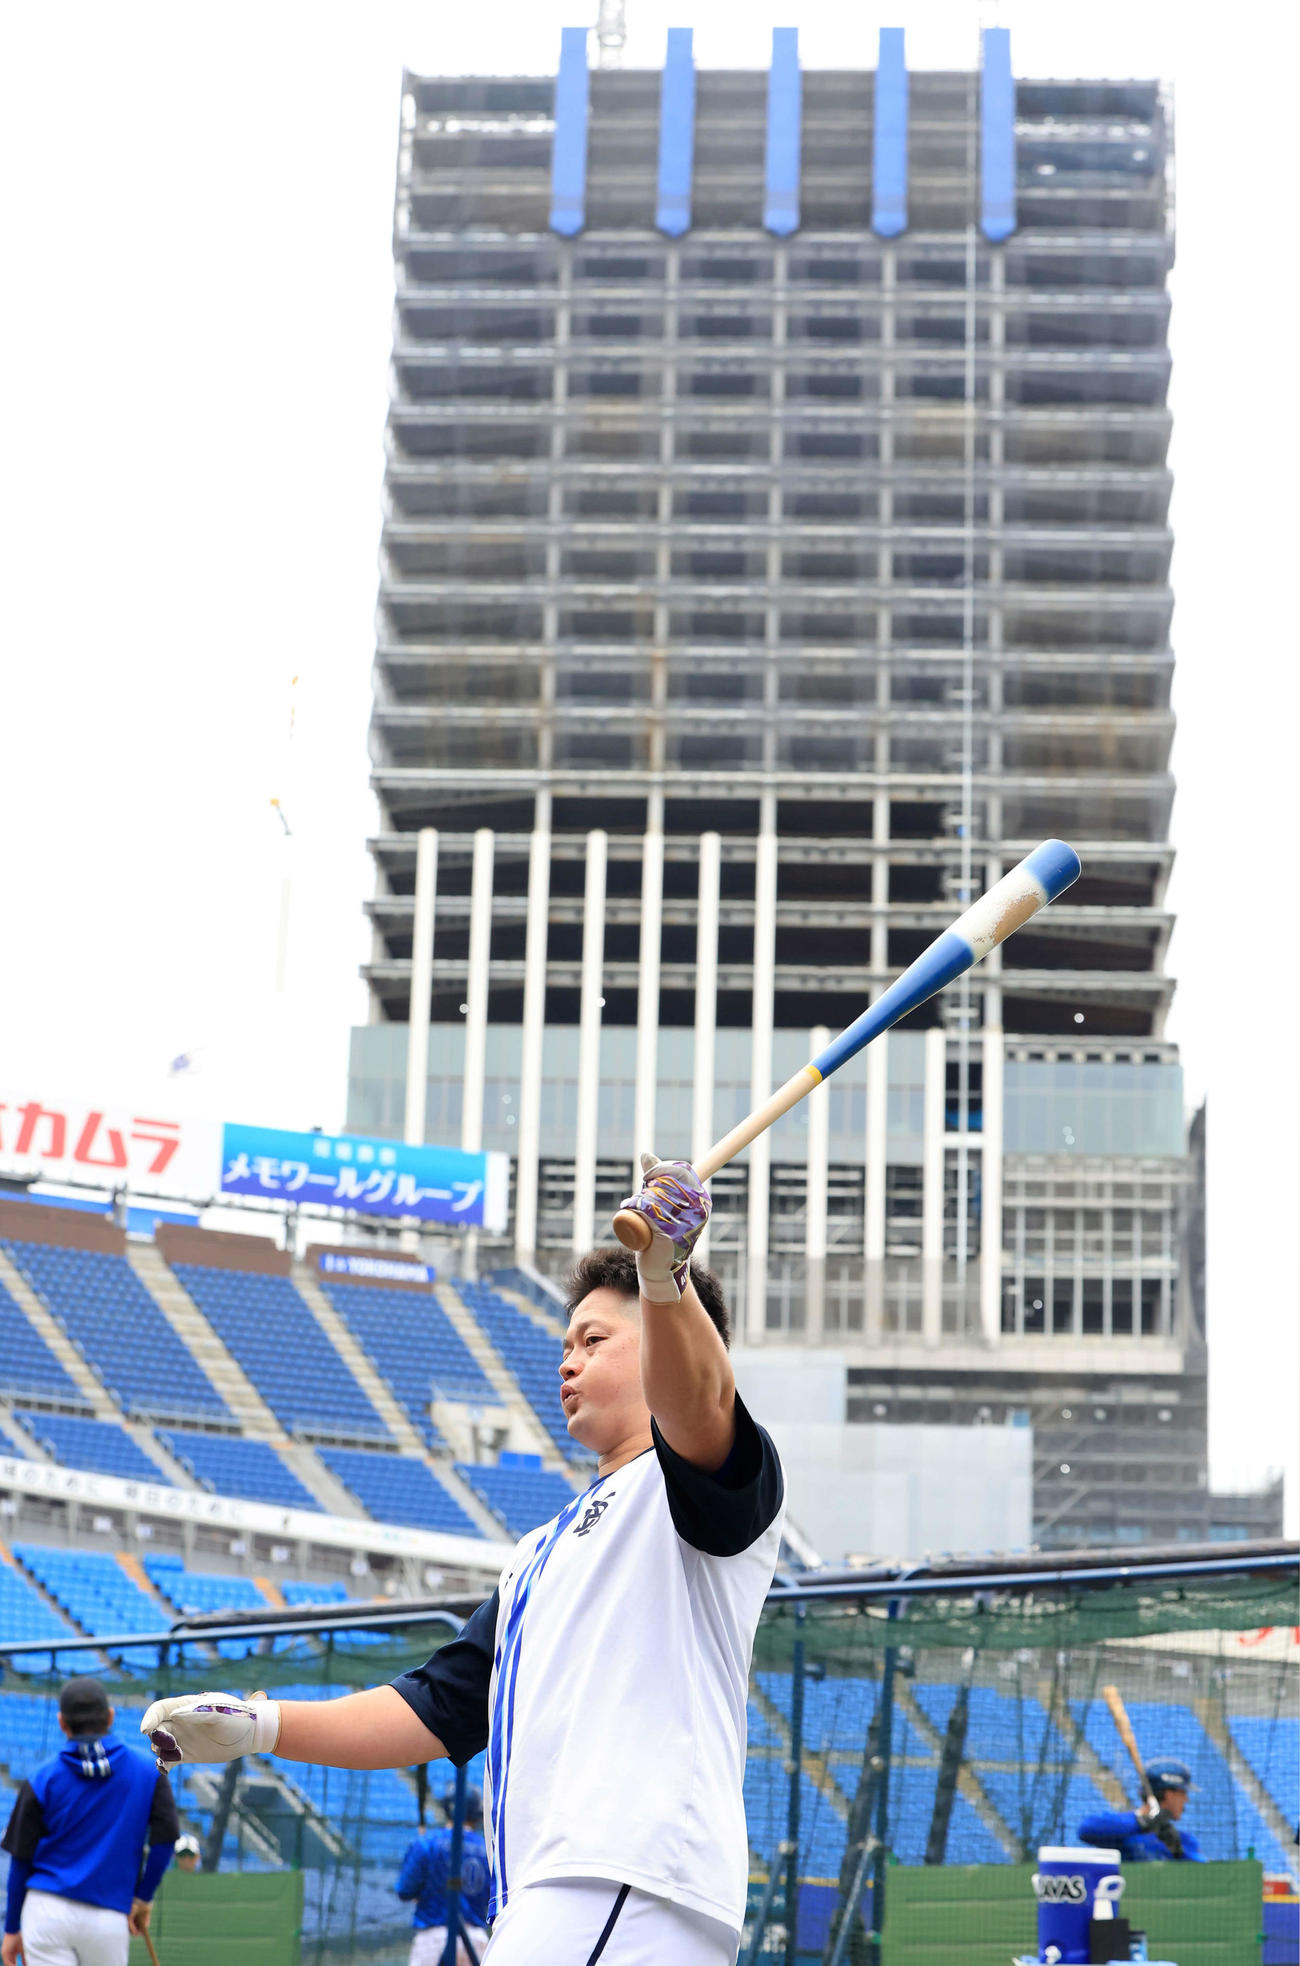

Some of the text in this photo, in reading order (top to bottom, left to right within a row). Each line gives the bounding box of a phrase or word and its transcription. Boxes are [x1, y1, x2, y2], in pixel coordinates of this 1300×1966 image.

[0, 1102, 180, 1174] カムラ
[223, 1152, 484, 1212] メモワールグループ
[1038, 1876, 1086, 1903] AVAS
